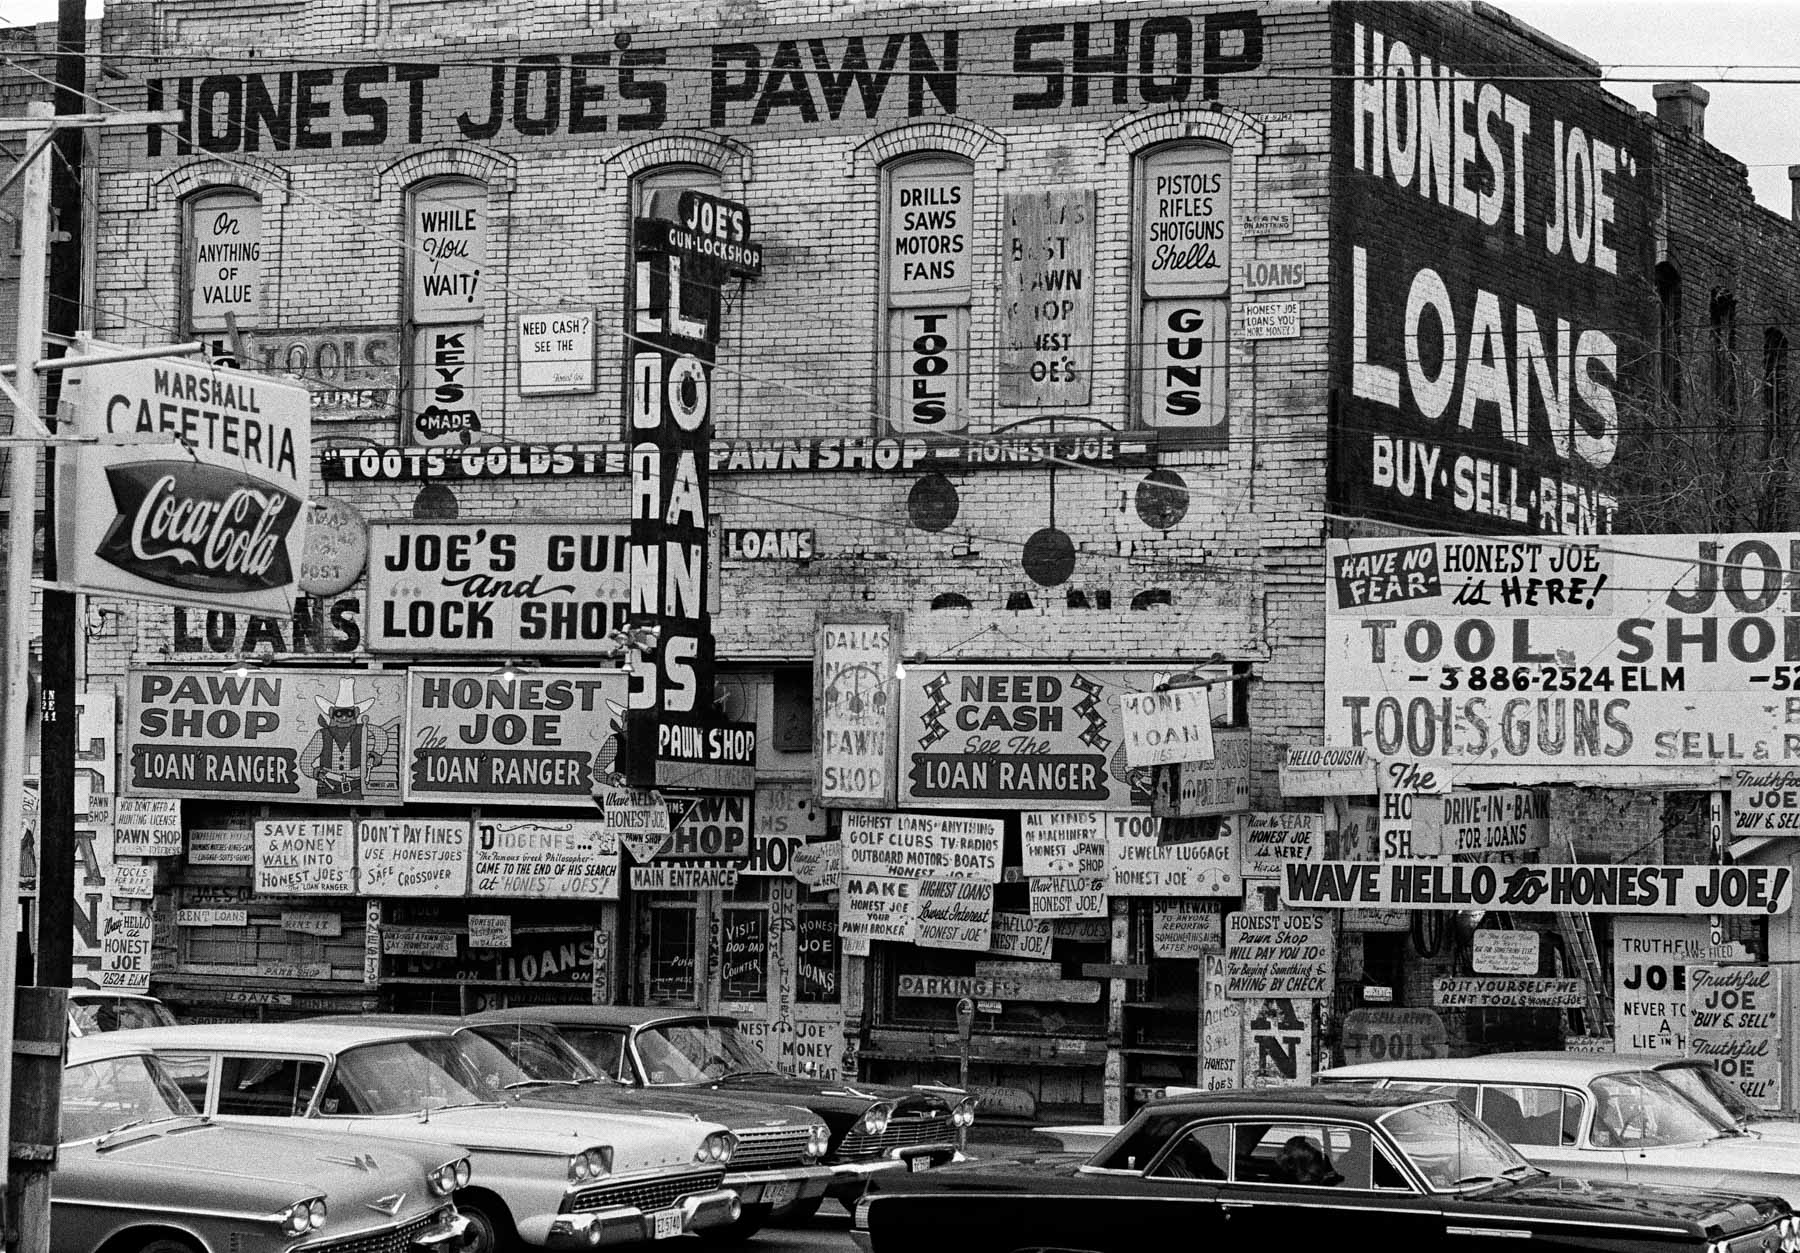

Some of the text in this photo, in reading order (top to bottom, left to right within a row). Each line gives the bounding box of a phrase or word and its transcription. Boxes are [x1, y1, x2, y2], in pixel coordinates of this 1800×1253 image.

[147, 9, 1263, 157] HONEST JOE'S PAWN SHOP
[1354, 22, 1530, 236] HONEST
[1157, 173, 1221, 195] PISTOLS
[900, 186, 961, 207] DRILLS
[1159, 197, 1213, 217] RIFLES
[213, 212, 240, 236] On
[422, 209, 476, 232] WHILE
[687, 199, 743, 241] JOE'S
[904, 210, 957, 231] SAWS
[1150, 220, 1224, 241] SHOTGUNS
[198, 242, 260, 263] ANYTHING
[423, 237, 469, 273] You
[896, 234, 964, 255] MOTORS
[1152, 243, 1221, 270] Shells
[218, 267, 238, 281] OF
[904, 260, 955, 280] FANS
[1246, 263, 1303, 287] LOANS
[203, 285, 252, 303] VALUE
[523, 322, 547, 335] NEED
[534, 340, 573, 353] SEE THE
[1353, 245, 1617, 469] LOANS
[260, 338, 397, 380] TOOLS
[435, 333, 465, 403] KEYS
[913, 314, 948, 424] TOOLS
[1166, 309, 1204, 416] GUNS
[154, 369, 260, 413] MARSHALL
[107, 394, 297, 481] CAFETERIA
[709, 437, 1114, 471] PAWN SHOP HONEST JOE
[666, 255, 708, 711] LOANS
[384, 528, 517, 574] JOE'S
[728, 531, 813, 559] LOANS
[1340, 548, 1434, 579] HAVE NO
[1443, 543, 1600, 572] HONEST JOE
[441, 573, 575, 597] and
[1454, 575, 1608, 610] is HERE!
[383, 601, 493, 638] LOCK
[825, 631, 890, 650] DALLAS
[1361, 618, 1554, 664] TOOL
[960, 675, 1062, 703] NEED
[1622, 667, 1685, 691] ELM
[141, 675, 282, 706] PAWN
[422, 678, 602, 711] HONEST
[139, 708, 280, 740] SHOP
[955, 705, 1062, 733] CASH
[1503, 698, 1634, 757] GUNS
[459, 714, 561, 746] JOE
[658, 724, 755, 761] PAWN SHOP
[963, 735, 1051, 754] See The
[1655, 731, 1744, 759] SELL
[205, 754, 289, 785] RANGER
[491, 756, 580, 787] RANGER
[824, 766, 881, 792] SHOP
[999, 760, 1096, 792] RANGER
[1389, 763, 1437, 792] The
[1750, 791, 1797, 809] JOE
[607, 810, 650, 828] HONEST
[848, 815, 892, 829] HIGHEST
[1027, 814, 1042, 825] ALL
[116, 829, 149, 844] PAWN
[154, 829, 180, 845] SHOP
[264, 824, 343, 837] SAVE TIME
[361, 823, 463, 844] DON'T PAY FINES
[850, 831, 933, 849] GOLF CLUBS
[1250, 831, 1312, 844] HONEST JOE
[1459, 824, 1527, 849] FOR LOANS
[282, 839, 335, 851] MONEY
[364, 849, 462, 861] USE HONEST JOES
[1079, 843, 1105, 855] PAWN
[1119, 846, 1229, 861] JEWELRY LUGGAGE
[303, 854, 333, 865] INTO
[851, 848, 903, 865] OUTBOARD
[1079, 859, 1104, 872] SHOP
[368, 866, 452, 886] SAFE CROSSOVER
[476, 862, 617, 877] CAME TO OF SEARCH
[634, 869, 735, 886] MAIN ENTRANCE
[847, 880, 910, 898] MAKE
[919, 880, 991, 901] HIGHEST LOANS
[1286, 864, 1790, 914] WAVE HELLO to HONEST JOE!
[850, 900, 909, 913] HONEST JOE
[1032, 895, 1073, 911] HONEST
[124, 915, 150, 929] HELLO
[215, 911, 245, 922] LOANS
[1231, 914, 1323, 930] HONEST JOE'S
[126, 928, 139, 938] at
[726, 921, 756, 940] VISIT
[1239, 931, 1308, 945] Pawn Shop
[105, 939, 149, 954] HONEST
[799, 940, 832, 952] JOE
[1229, 946, 1298, 960] WILL PAY YOU
[111, 955, 140, 970] JOE
[128, 973, 148, 986] ELM
[900, 977, 985, 996] PARKING
[1229, 977, 1327, 992] PAYING BY CHECK
[1692, 969, 1770, 991] Truthful
[1442, 994, 1476, 1005] RENT
[1624, 1002, 1665, 1016] NEVER
[1705, 990, 1755, 1010] JOE
[782, 1042, 832, 1058] MONEY
[1633, 1035, 1656, 1049] LIE
[1692, 1038, 1769, 1060] Truthful
[1204, 1057, 1235, 1071] HONEST
